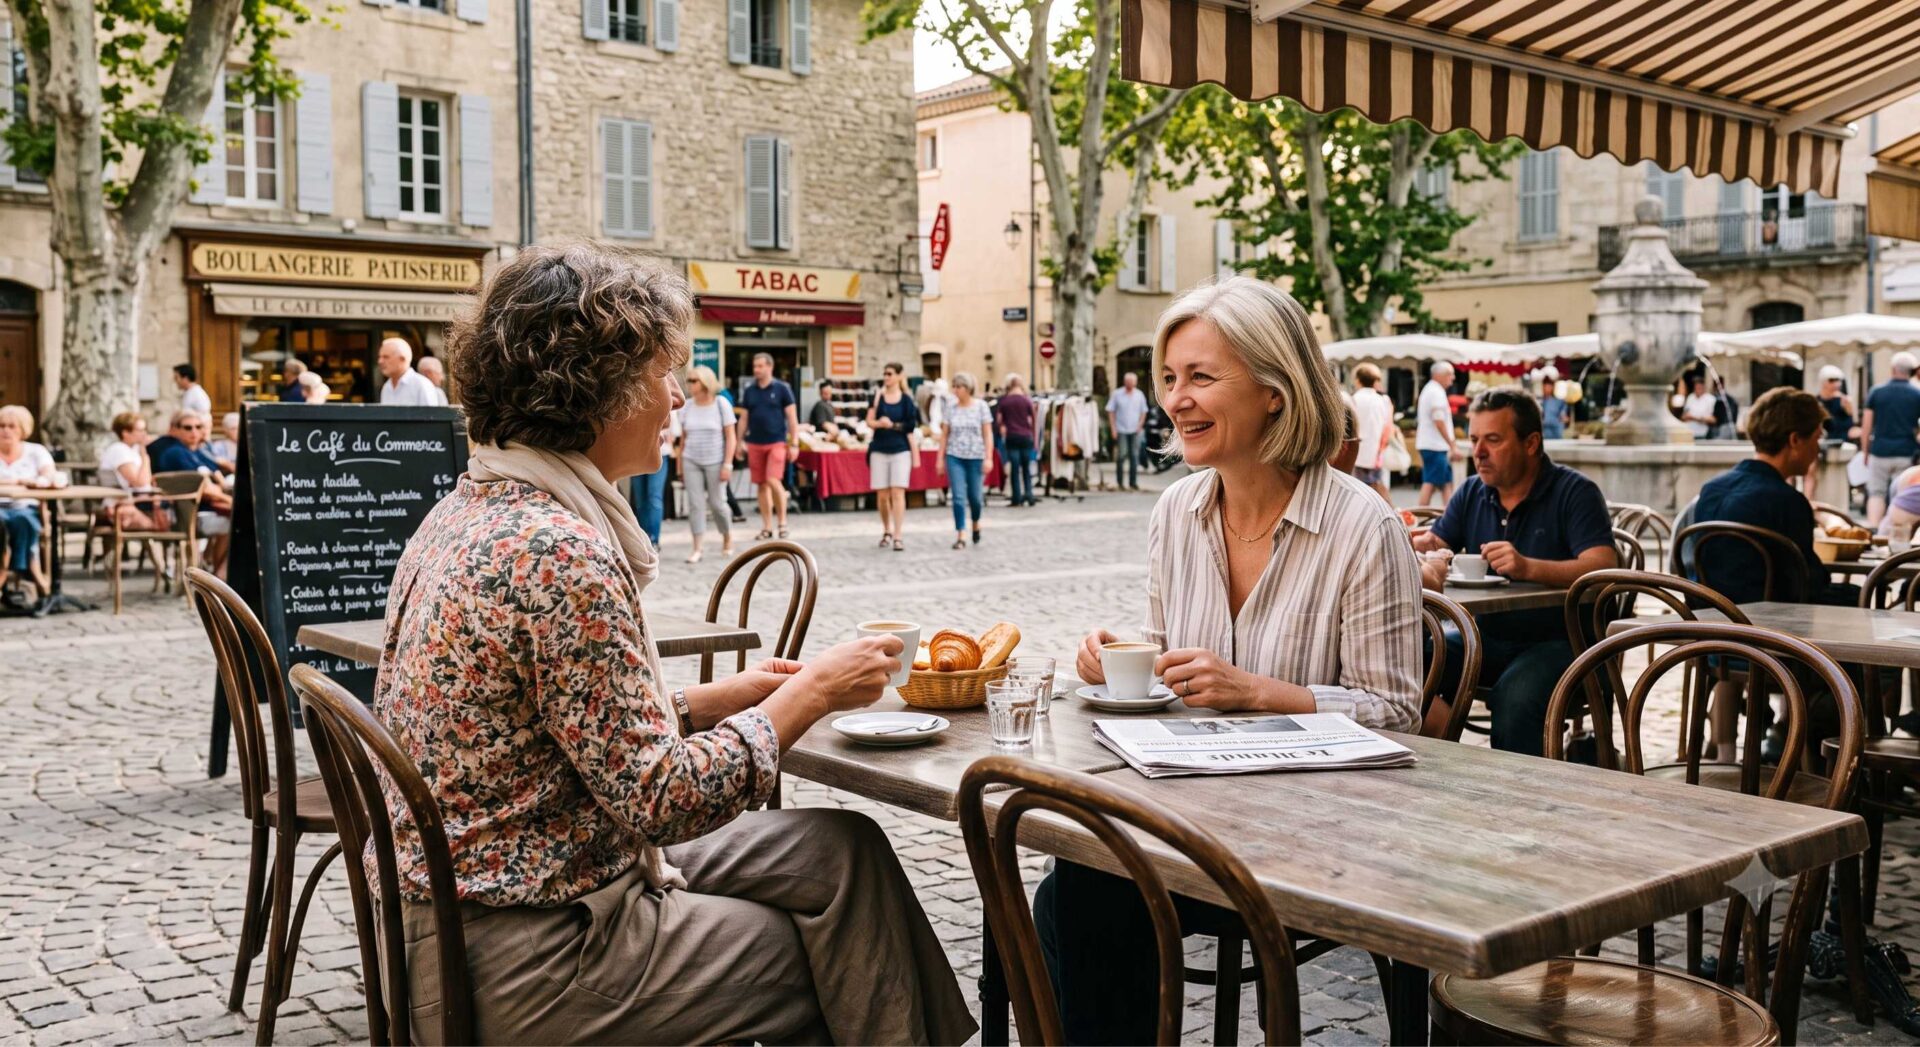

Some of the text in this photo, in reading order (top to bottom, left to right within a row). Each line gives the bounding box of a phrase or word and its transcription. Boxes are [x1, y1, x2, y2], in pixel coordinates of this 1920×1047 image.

[206, 249, 471, 282] BOULANGERIE PATISSERIE
[736, 268, 819, 293] TABAC
[252, 297, 273, 312] LE
[332, 301, 352, 315] DE
[276, 427, 446, 461] Le Café du Commerce
